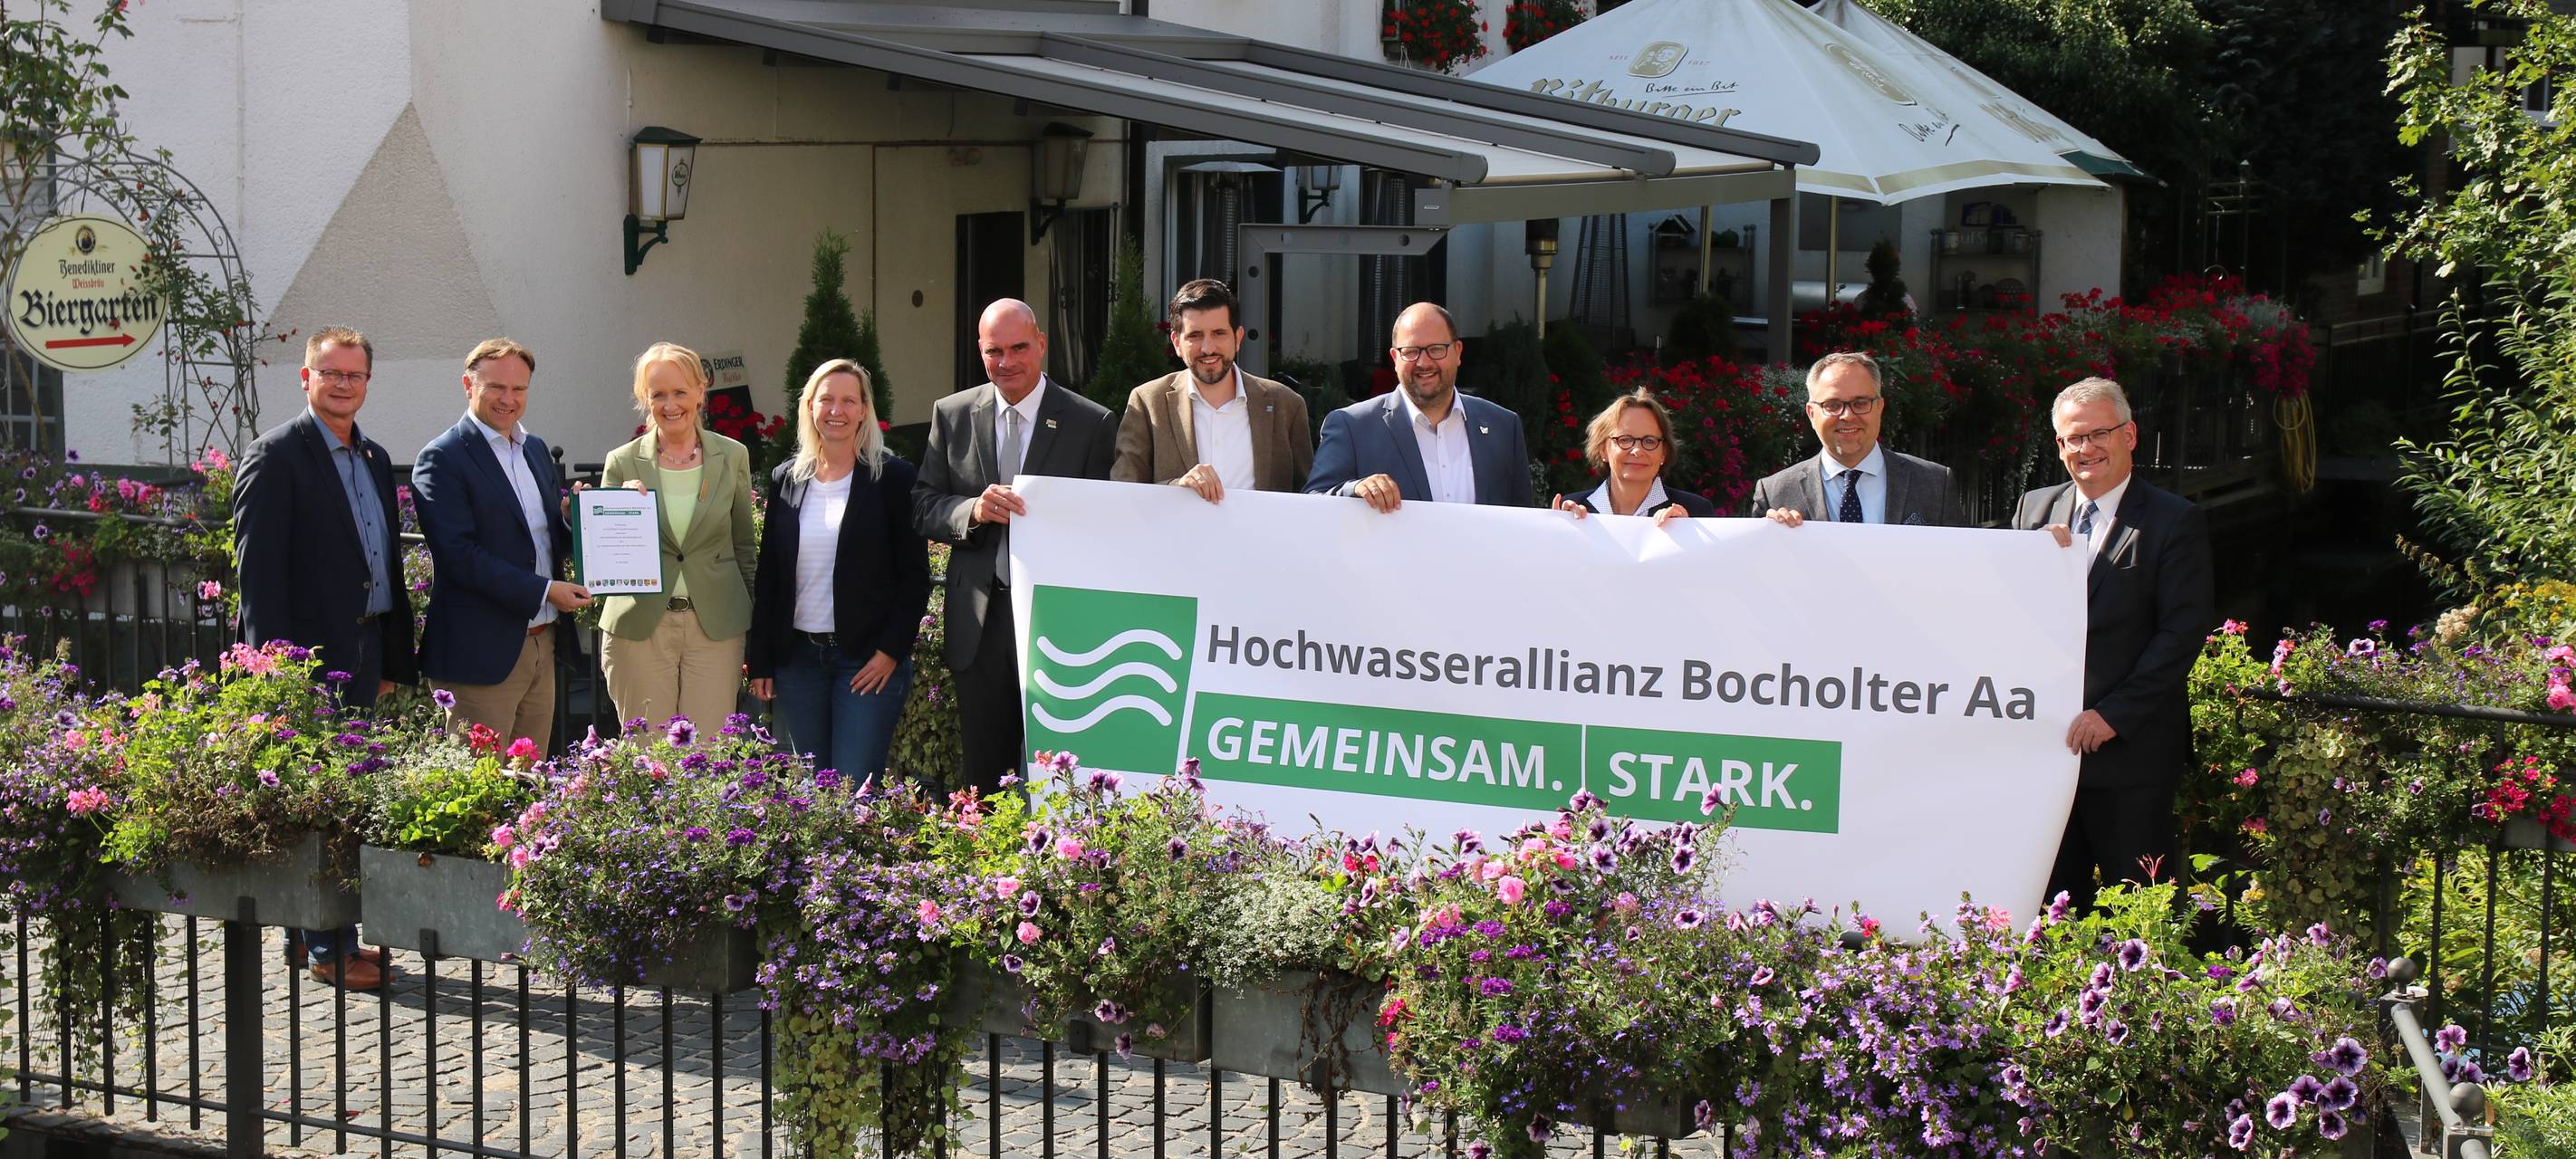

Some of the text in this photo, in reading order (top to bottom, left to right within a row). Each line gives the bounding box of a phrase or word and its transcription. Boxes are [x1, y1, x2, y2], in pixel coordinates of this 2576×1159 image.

[58, 259, 115, 279] Benediktiner
[20, 289, 158, 336] Biergarten
[713, 356, 745, 370] ERDINGER
[1207, 624, 2036, 720] Hochwasserallianz Bocholter Aa
[1207, 716, 1812, 811] GEMEINSAM. STARK.
